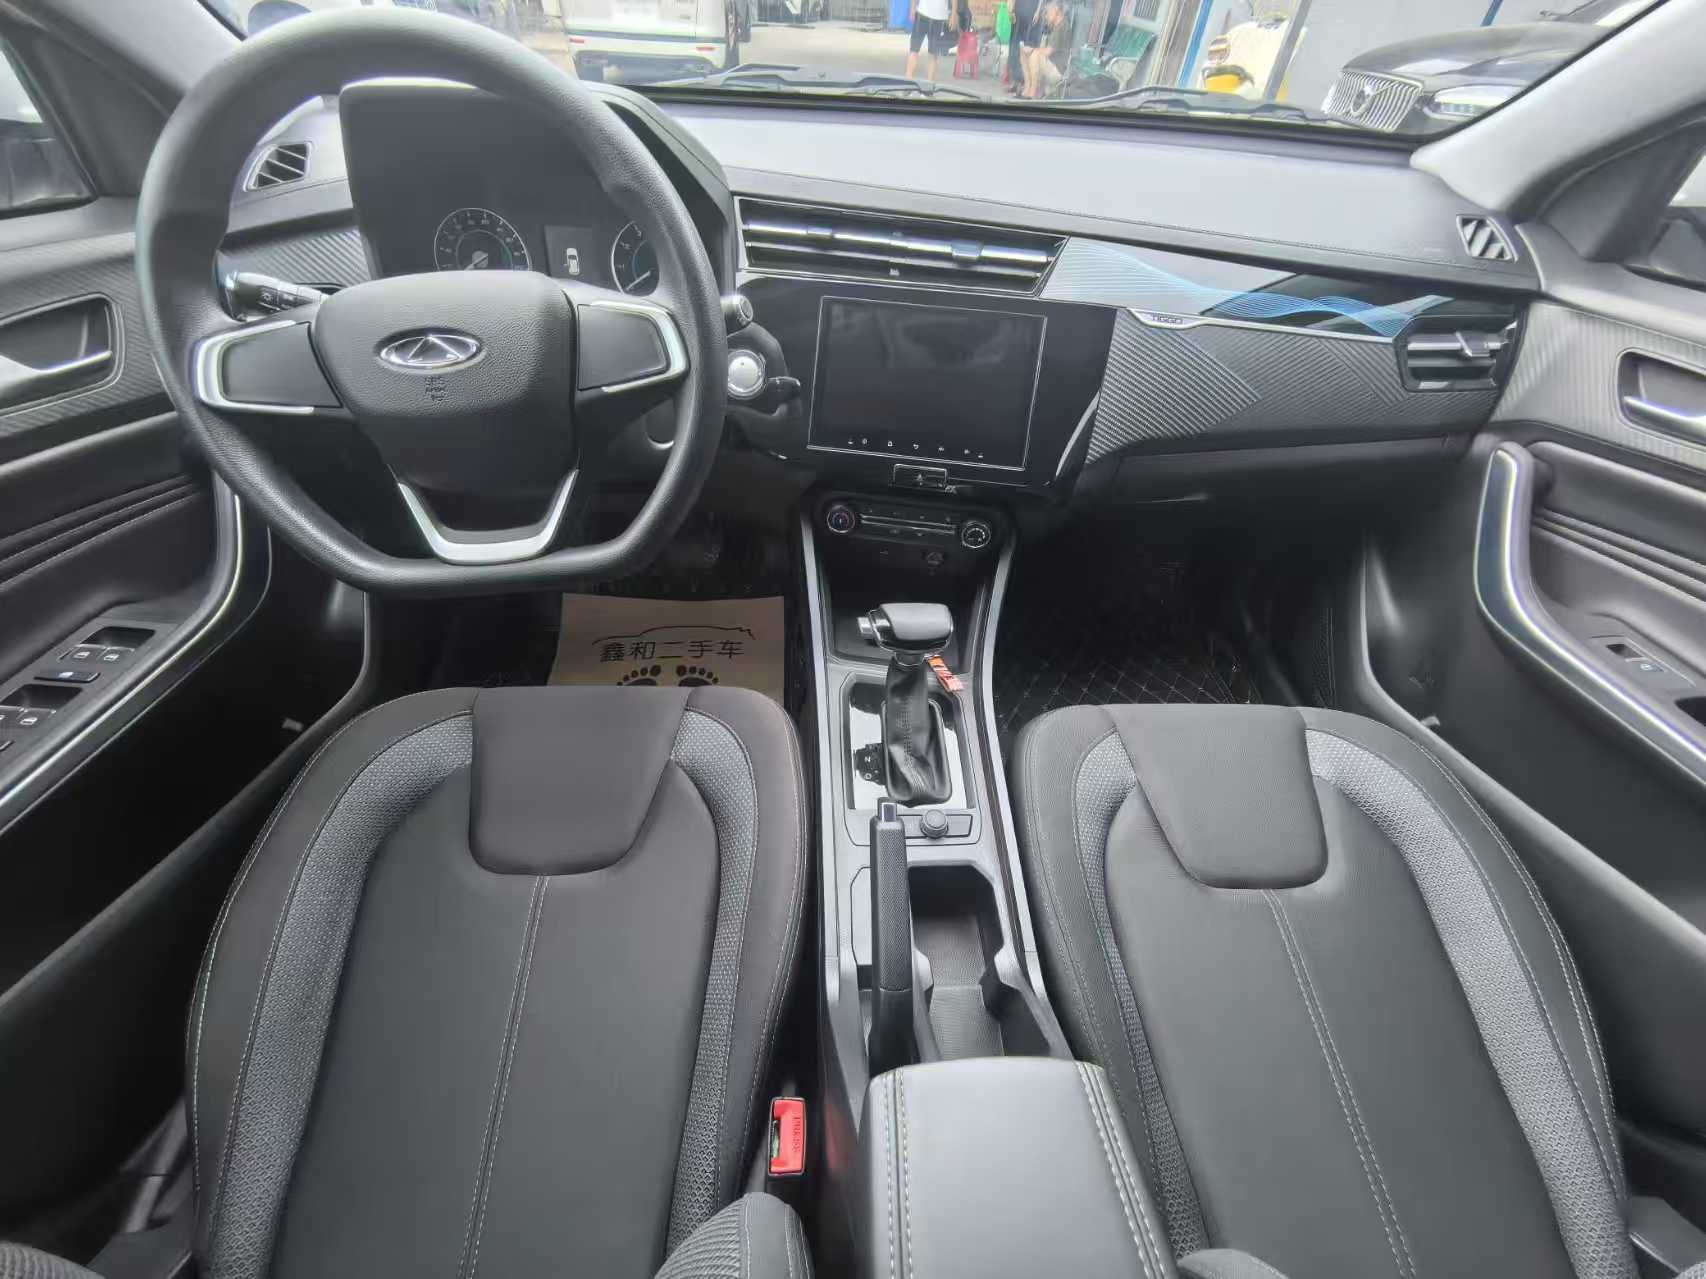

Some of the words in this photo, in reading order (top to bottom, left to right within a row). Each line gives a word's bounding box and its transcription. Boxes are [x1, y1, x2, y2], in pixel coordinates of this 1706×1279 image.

[600, 640, 744, 662] 鑫和二手车
